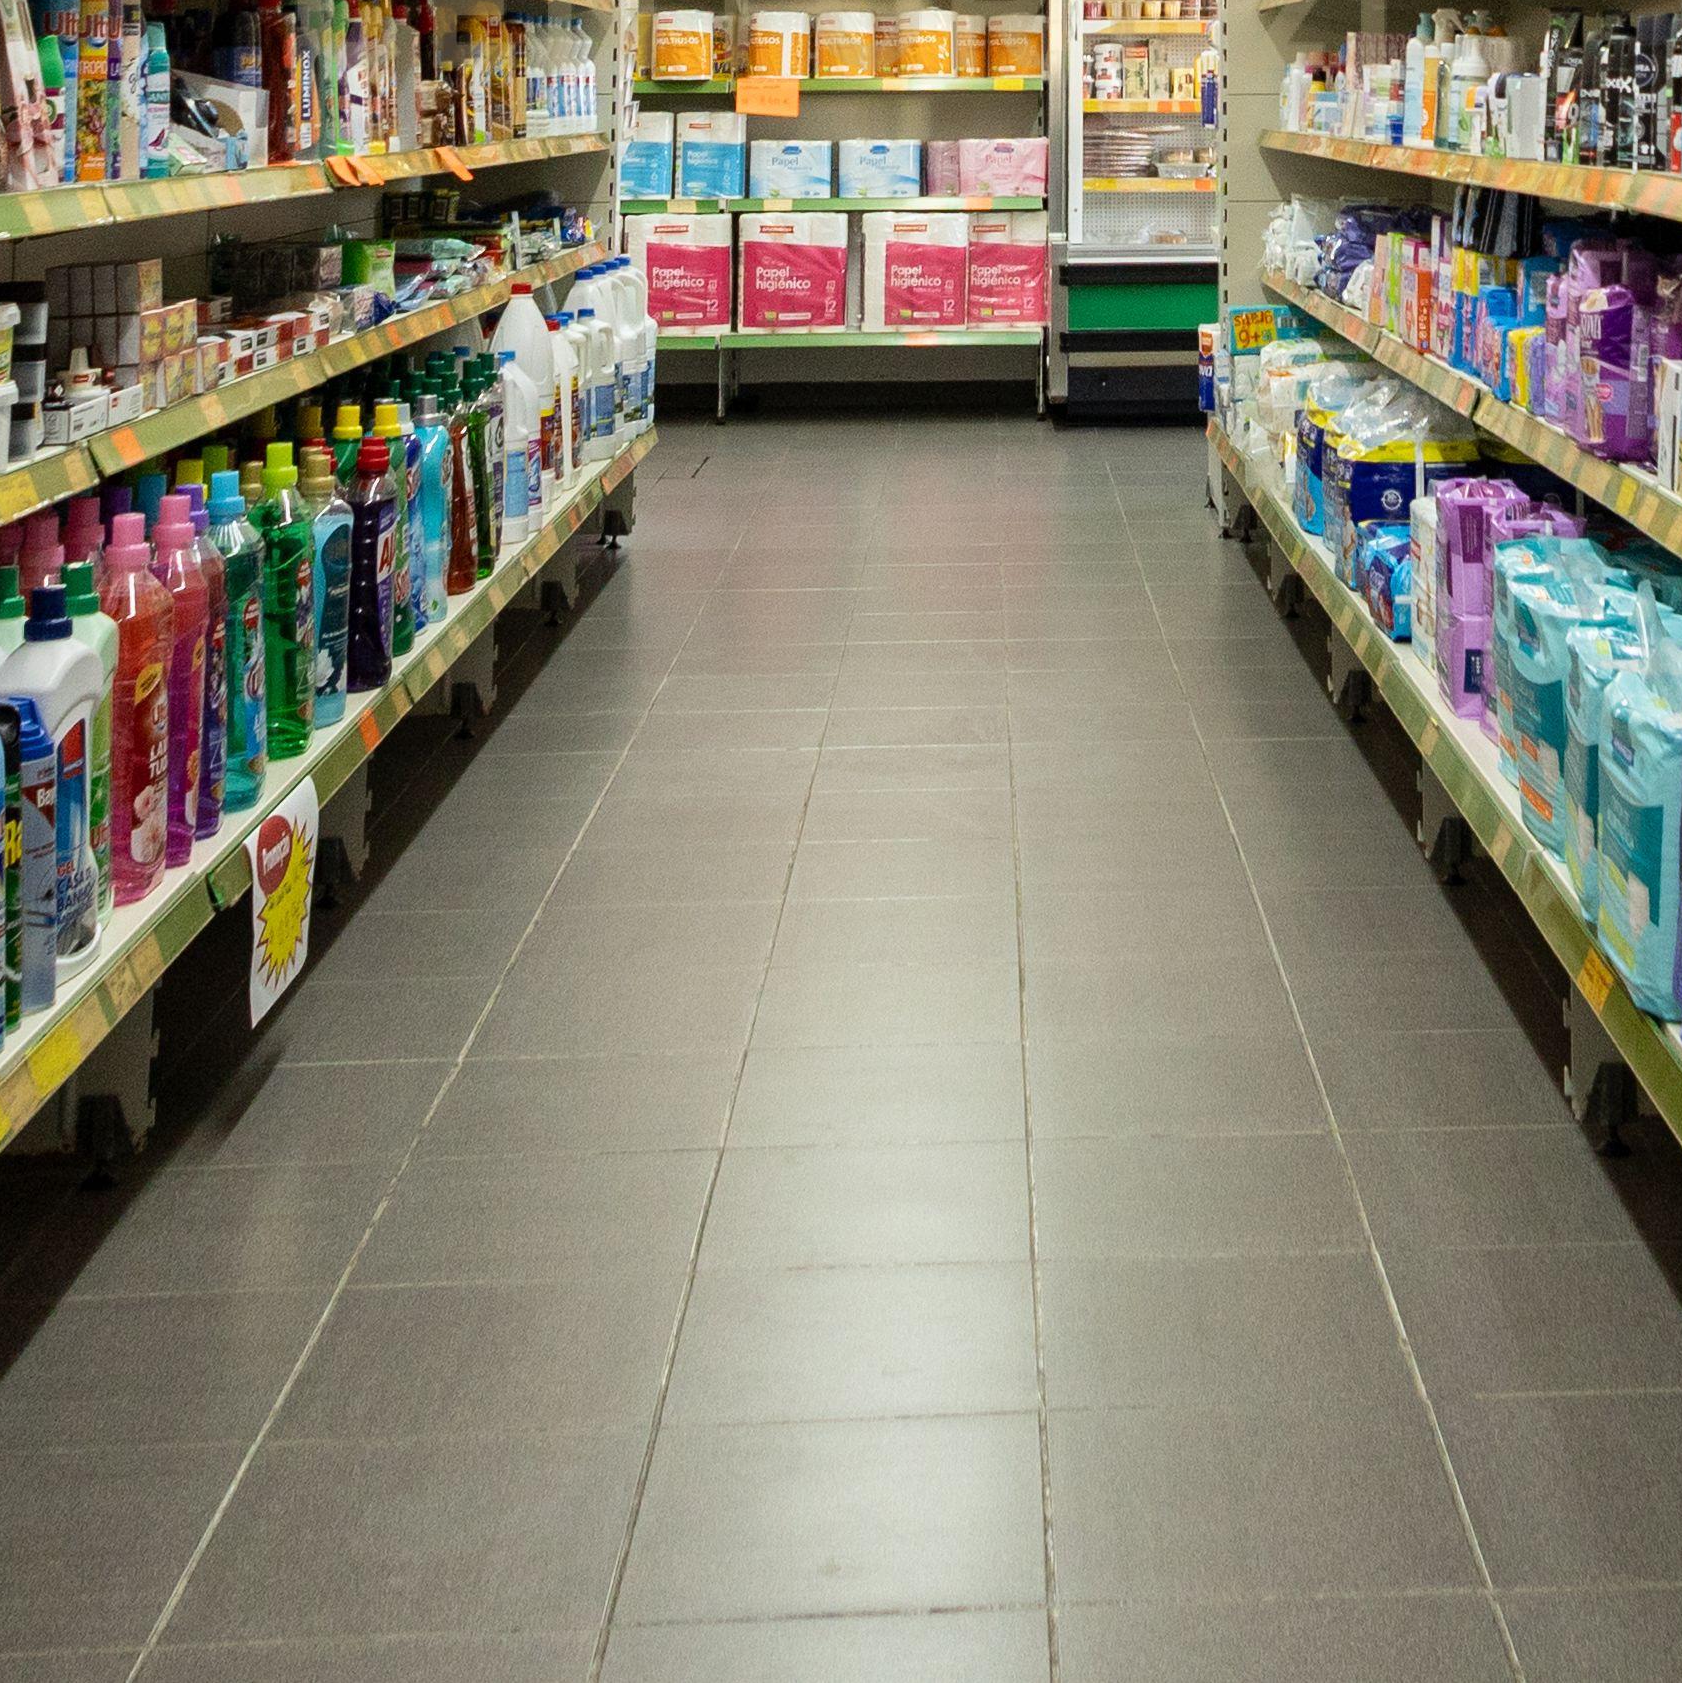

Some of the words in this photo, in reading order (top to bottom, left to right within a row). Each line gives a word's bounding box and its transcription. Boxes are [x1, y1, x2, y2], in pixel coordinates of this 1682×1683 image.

[300, 48, 311, 120] LUMINOX
[772, 156, 800, 167] Papel
[985, 154, 1013, 166] Papel
[652, 266, 685, 279] Papel
[755, 266, 790, 279] Papel
[891, 265, 923, 279] Papel
[970, 265, 1002, 278] Papel
[652, 277, 705, 291] higiénico
[755, 277, 812, 292] higiénico
[891, 276, 942, 289] higiénico
[970, 275, 1021, 288] higiénico
[825, 299, 837, 314] 12
[943, 299, 956, 312] 12
[1023, 298, 1036, 310] 12
